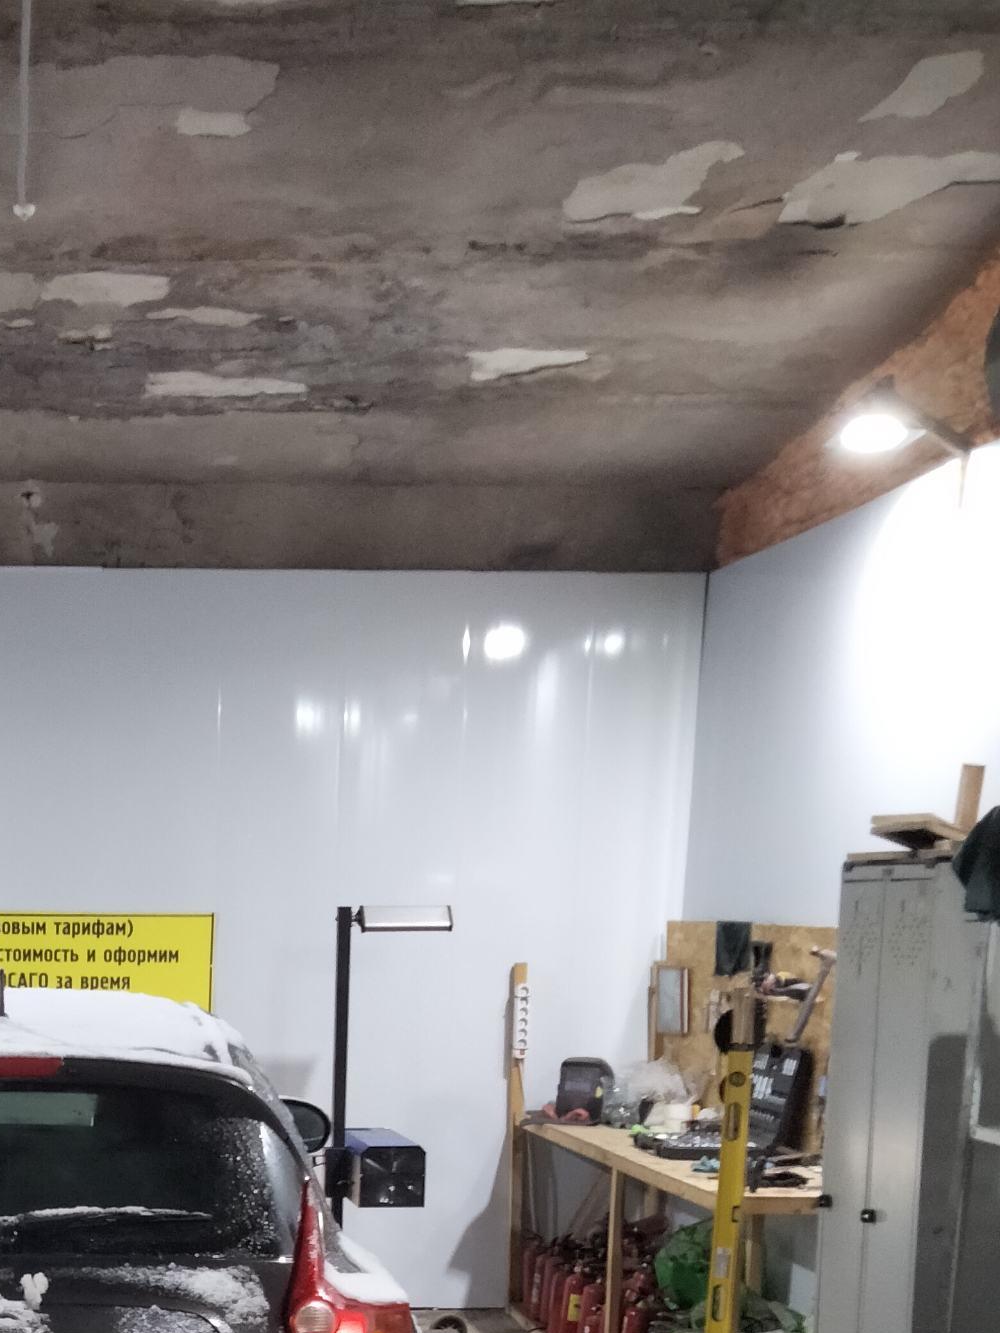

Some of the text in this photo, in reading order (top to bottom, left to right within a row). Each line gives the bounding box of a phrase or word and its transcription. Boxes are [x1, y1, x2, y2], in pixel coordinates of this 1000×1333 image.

[54, 919, 134, 938] тарифам)
[87, 949, 96, 962] и
[103, 946, 179, 966] оформим
[56, 975, 73, 989] за
[80, 976, 131, 990] время
